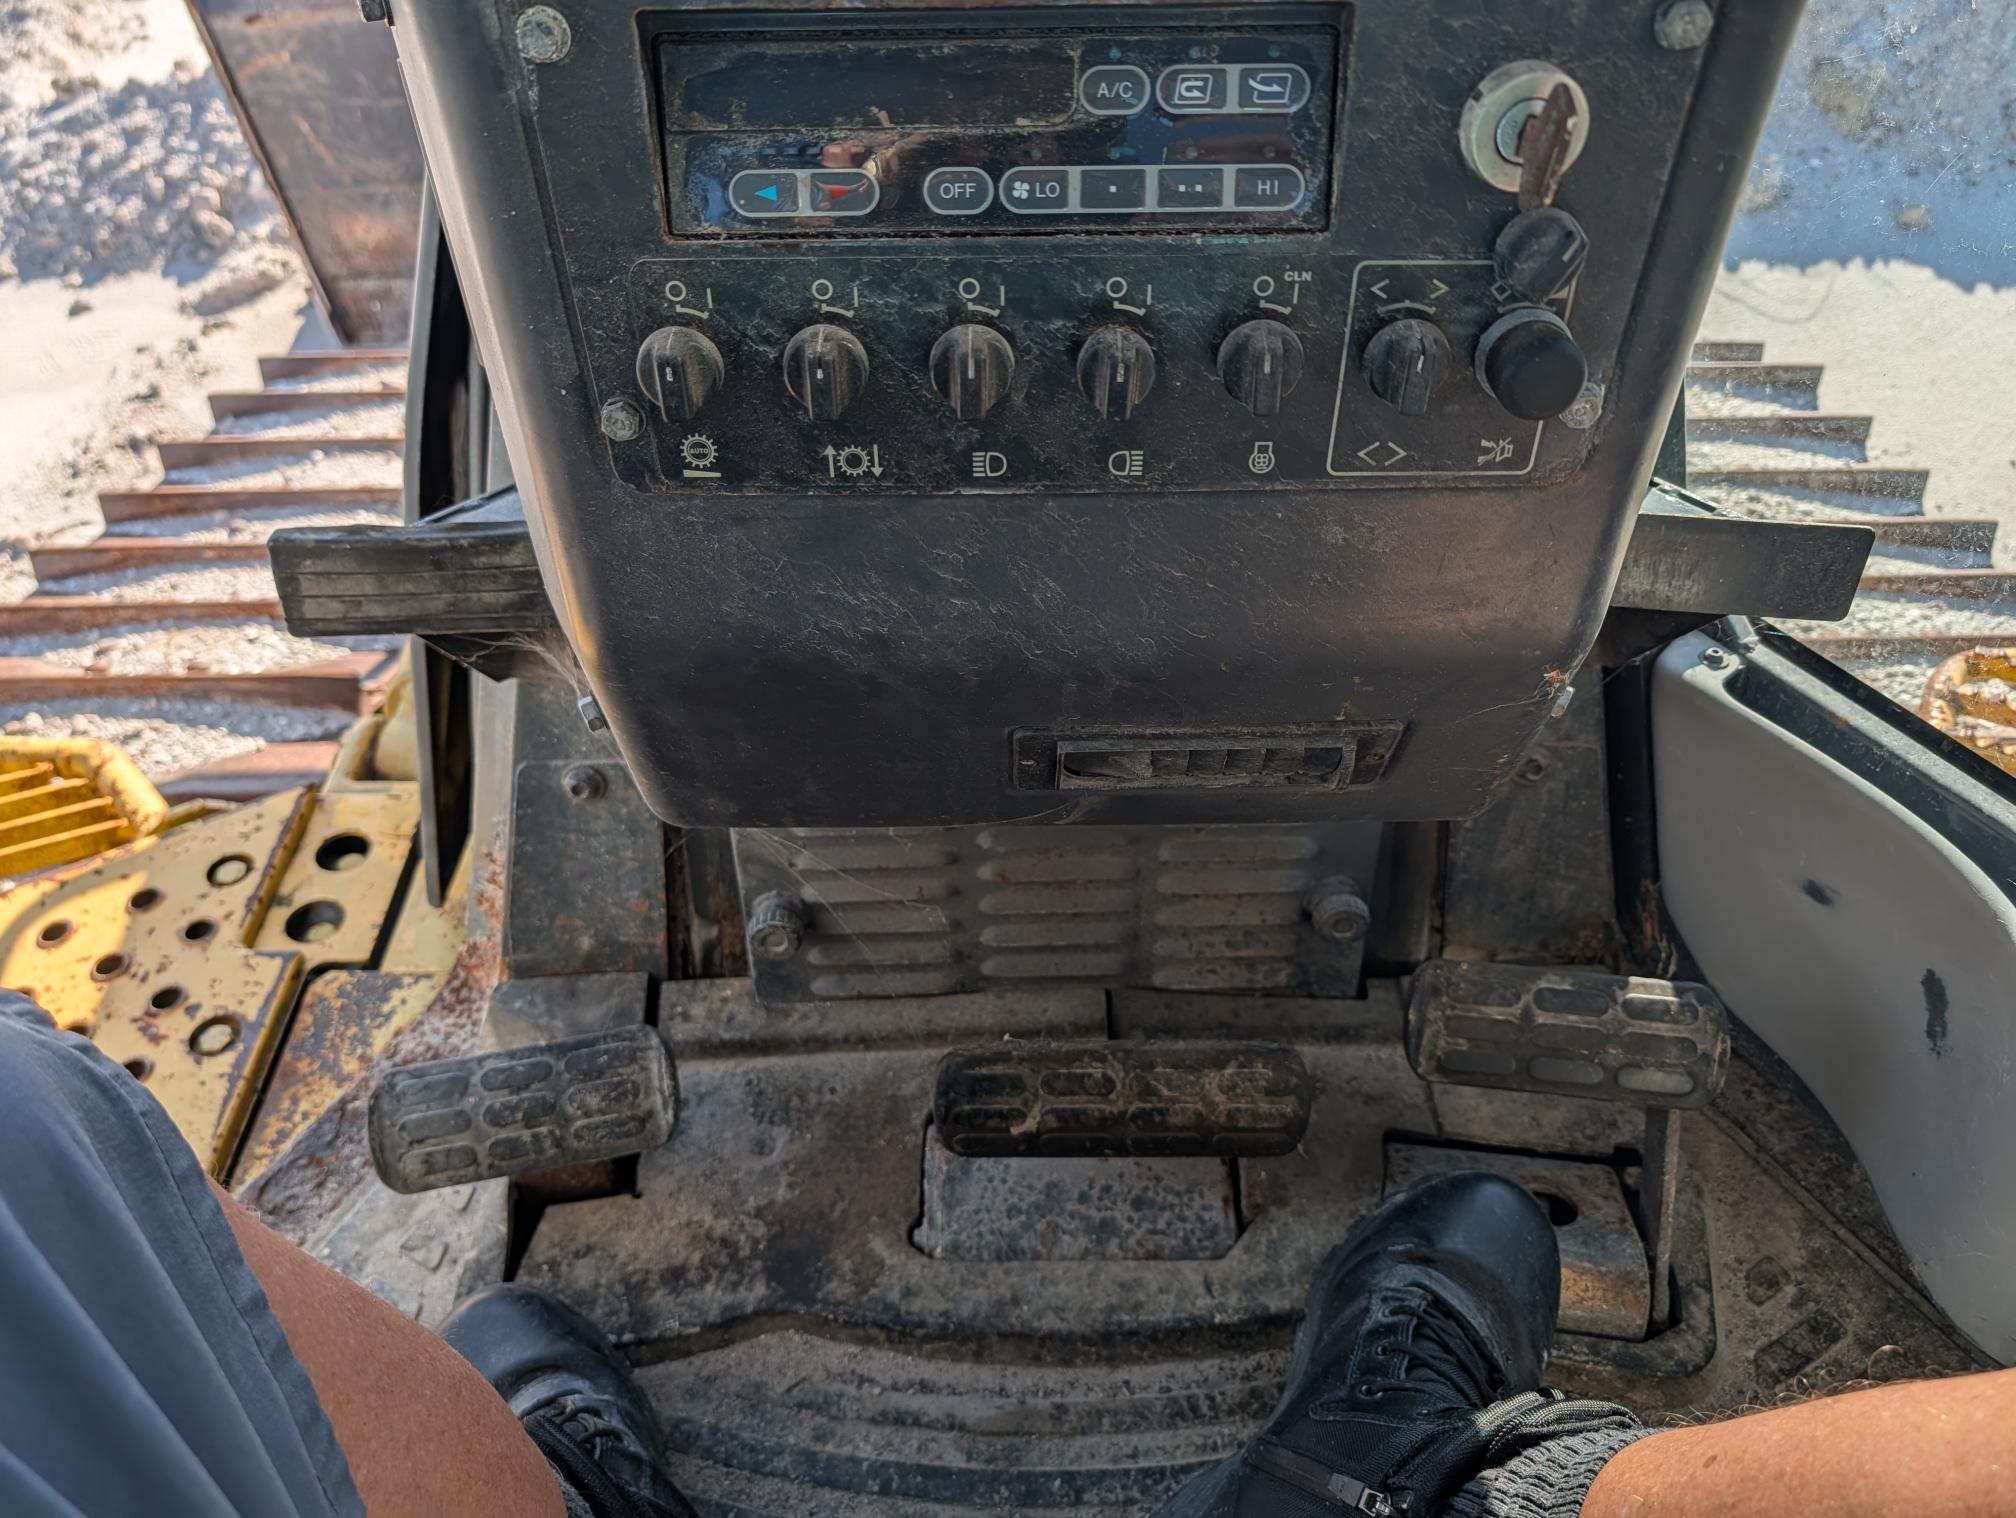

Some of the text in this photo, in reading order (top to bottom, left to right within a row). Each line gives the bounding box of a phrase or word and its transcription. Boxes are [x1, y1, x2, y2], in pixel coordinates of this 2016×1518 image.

[1096, 81, 1133, 98] A/C
[939, 182, 977, 199] OFF
[1035, 181, 1060, 198] LO
[1257, 179, 1279, 196] HI
[1284, 270, 1313, 282] CLN
[690, 447, 709, 455] AUTO
